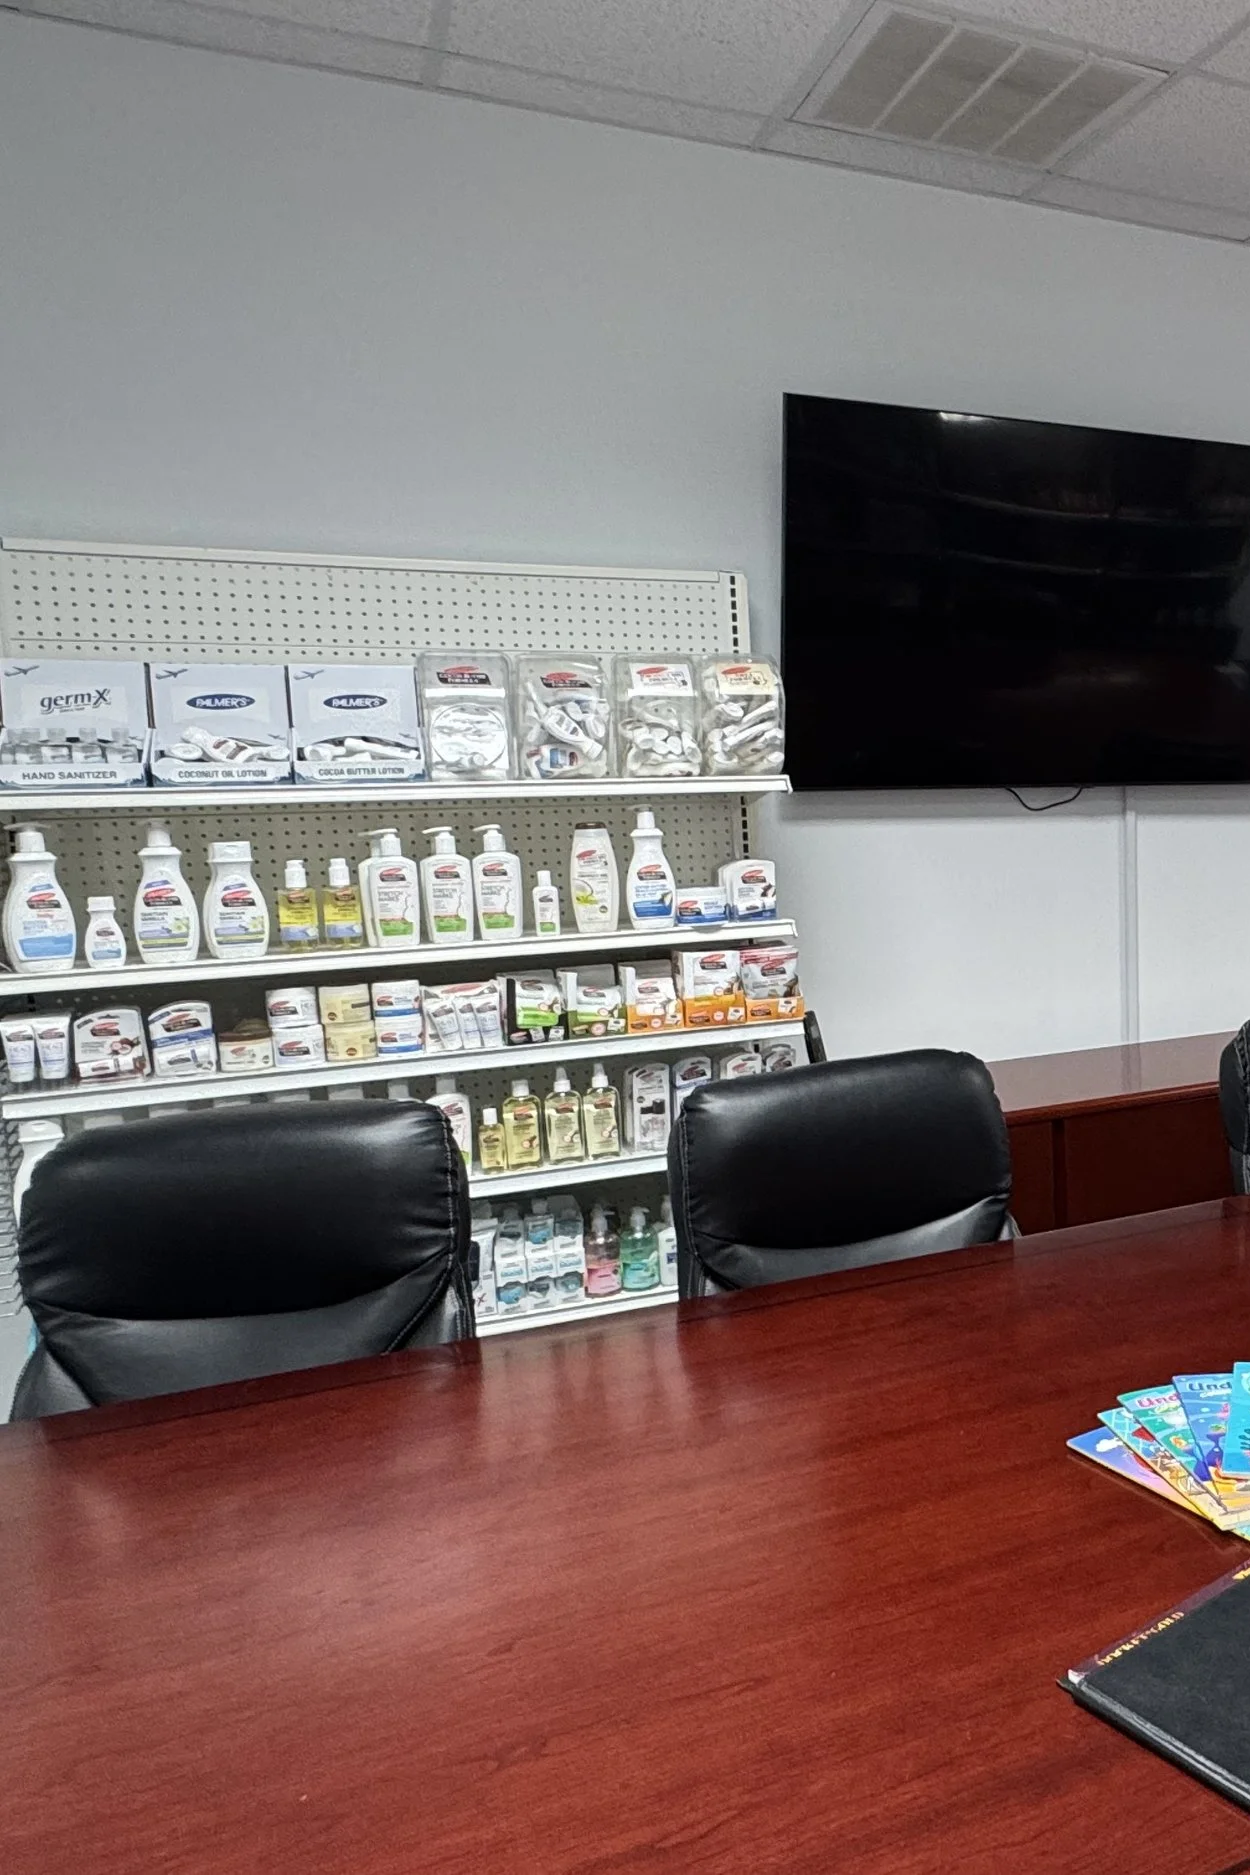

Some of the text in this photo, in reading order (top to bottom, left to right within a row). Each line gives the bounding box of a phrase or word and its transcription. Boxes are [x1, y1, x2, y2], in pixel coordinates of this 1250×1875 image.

[40, 688, 111, 715] germ-X
[195, 697, 249, 707] PALMER'S
[331, 697, 381, 707] PALMER'S
[22, 771, 117, 780] HAND SANITIZER
[178, 769, 267, 779] COCONUT OIL LOTION
[318, 767, 405, 776] COCOA BUTTER LOTION
